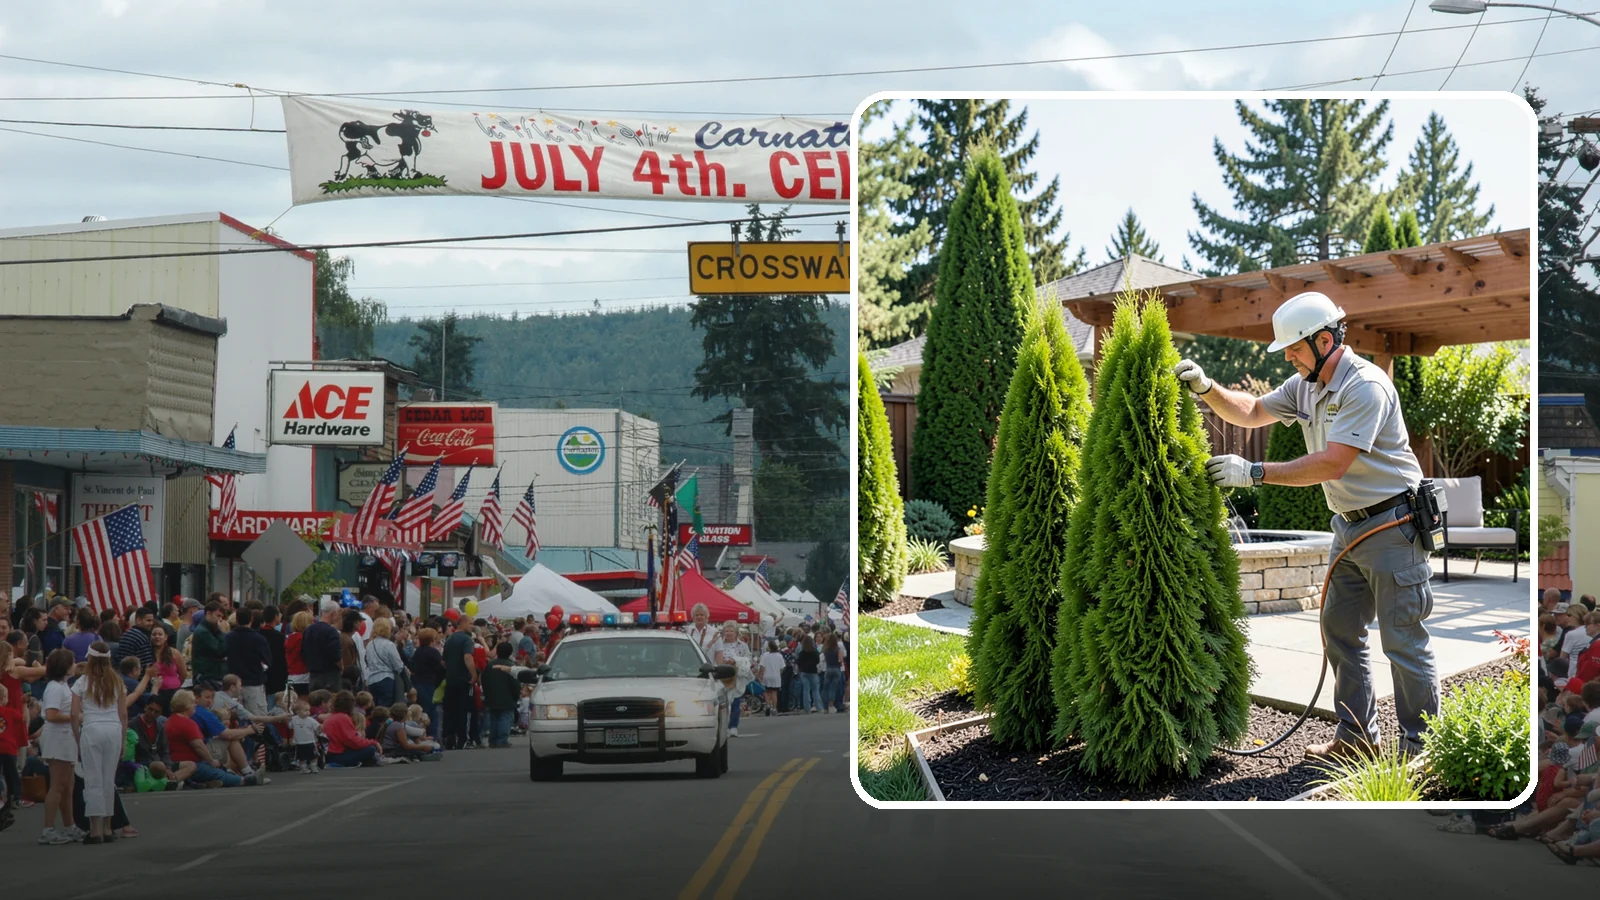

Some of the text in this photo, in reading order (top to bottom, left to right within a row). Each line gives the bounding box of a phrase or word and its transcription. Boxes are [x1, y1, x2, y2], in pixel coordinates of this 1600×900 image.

[695, 121, 850, 150] Carnat
[481, 141, 605, 192] JULY
[632, 150, 746, 198] 4th.
[697, 254, 850, 280] CROSSWA
[283, 380, 373, 420] ACE
[406, 409, 452, 422] CEDAR
[284, 421, 371, 436] Hardware
[353, 467, 385, 480] Simpl
[96, 486, 124, 494] Vincent
[138, 486, 155, 495] Paul
[699, 535, 730, 543] GLASS
